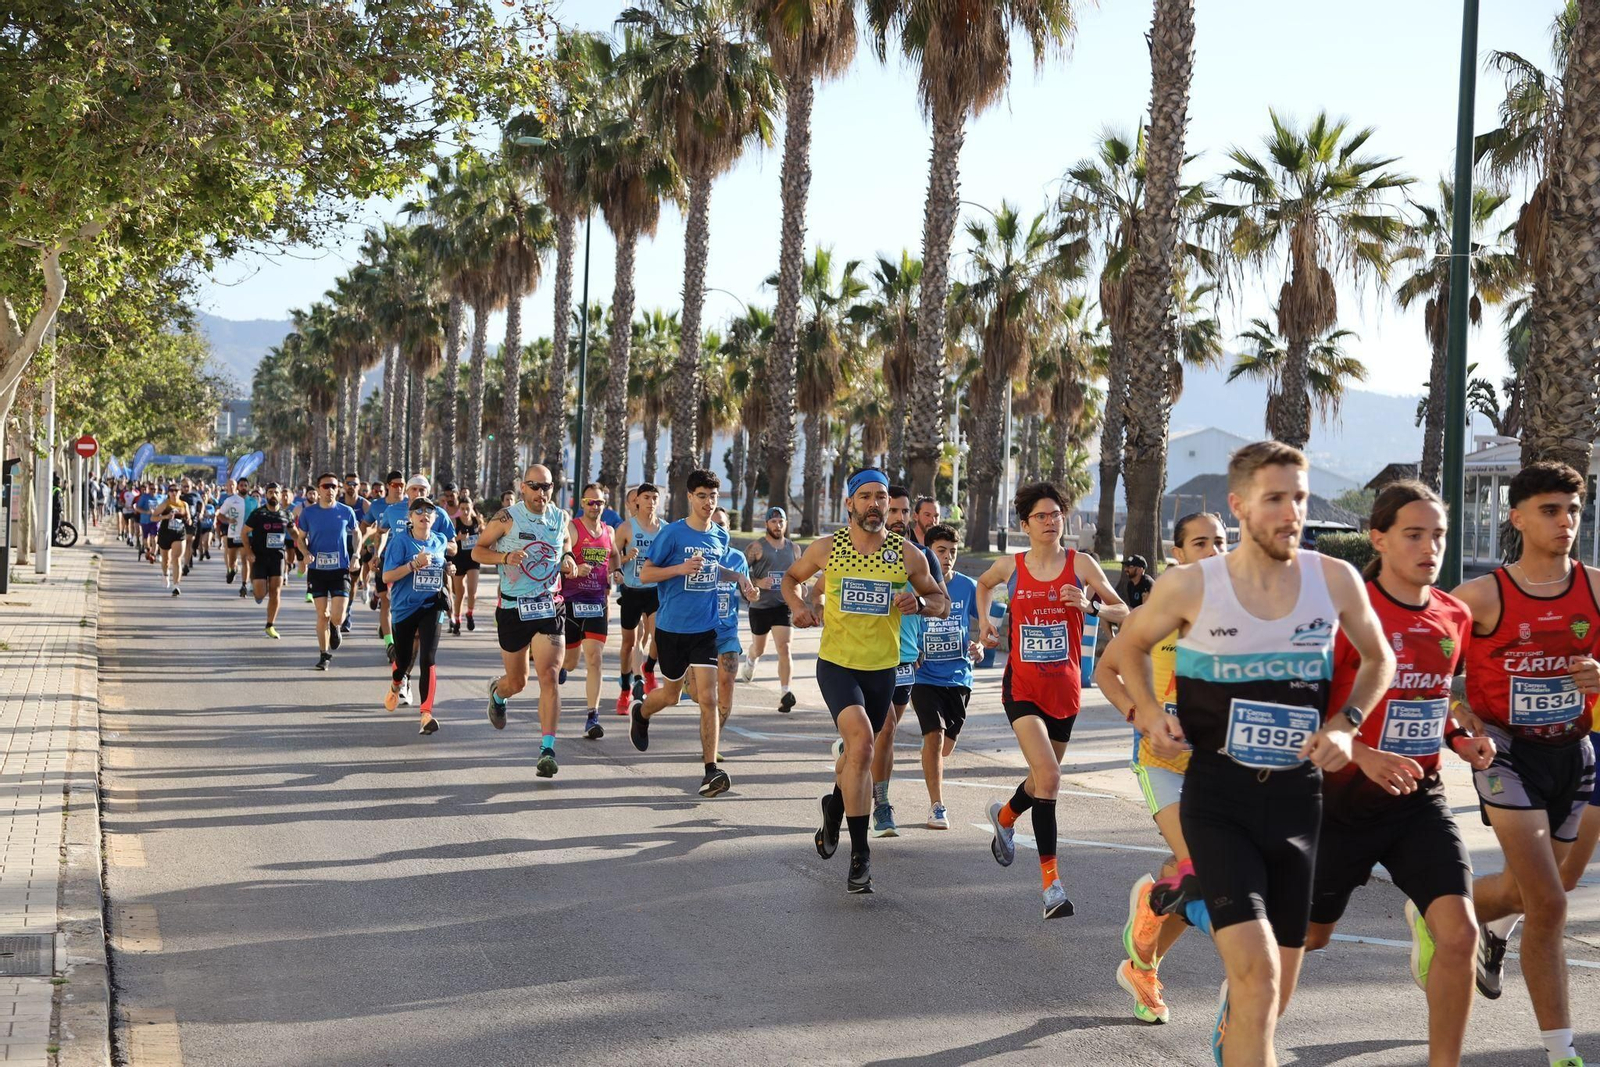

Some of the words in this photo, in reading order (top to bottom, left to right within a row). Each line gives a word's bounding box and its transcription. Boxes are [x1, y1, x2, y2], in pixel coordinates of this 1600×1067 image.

[416, 576, 441, 584] 1773
[846, 591, 885, 604] 2053
[522, 602, 552, 612] 1669
[1032, 608, 1067, 616] ATLETISMO
[1209, 626, 1239, 637] vive
[927, 641, 958, 652] 2209
[1026, 638, 1064, 650] 2112
[1212, 655, 1325, 680] inacua
[1521, 692, 1577, 710] 1634
[1246, 708, 1273, 717] Carrera
[1288, 711, 1316, 719] mayoral
[1245, 715, 1276, 724] Solidaria
[1394, 721, 1440, 738] 1681
[1240, 726, 1306, 749] 1992
